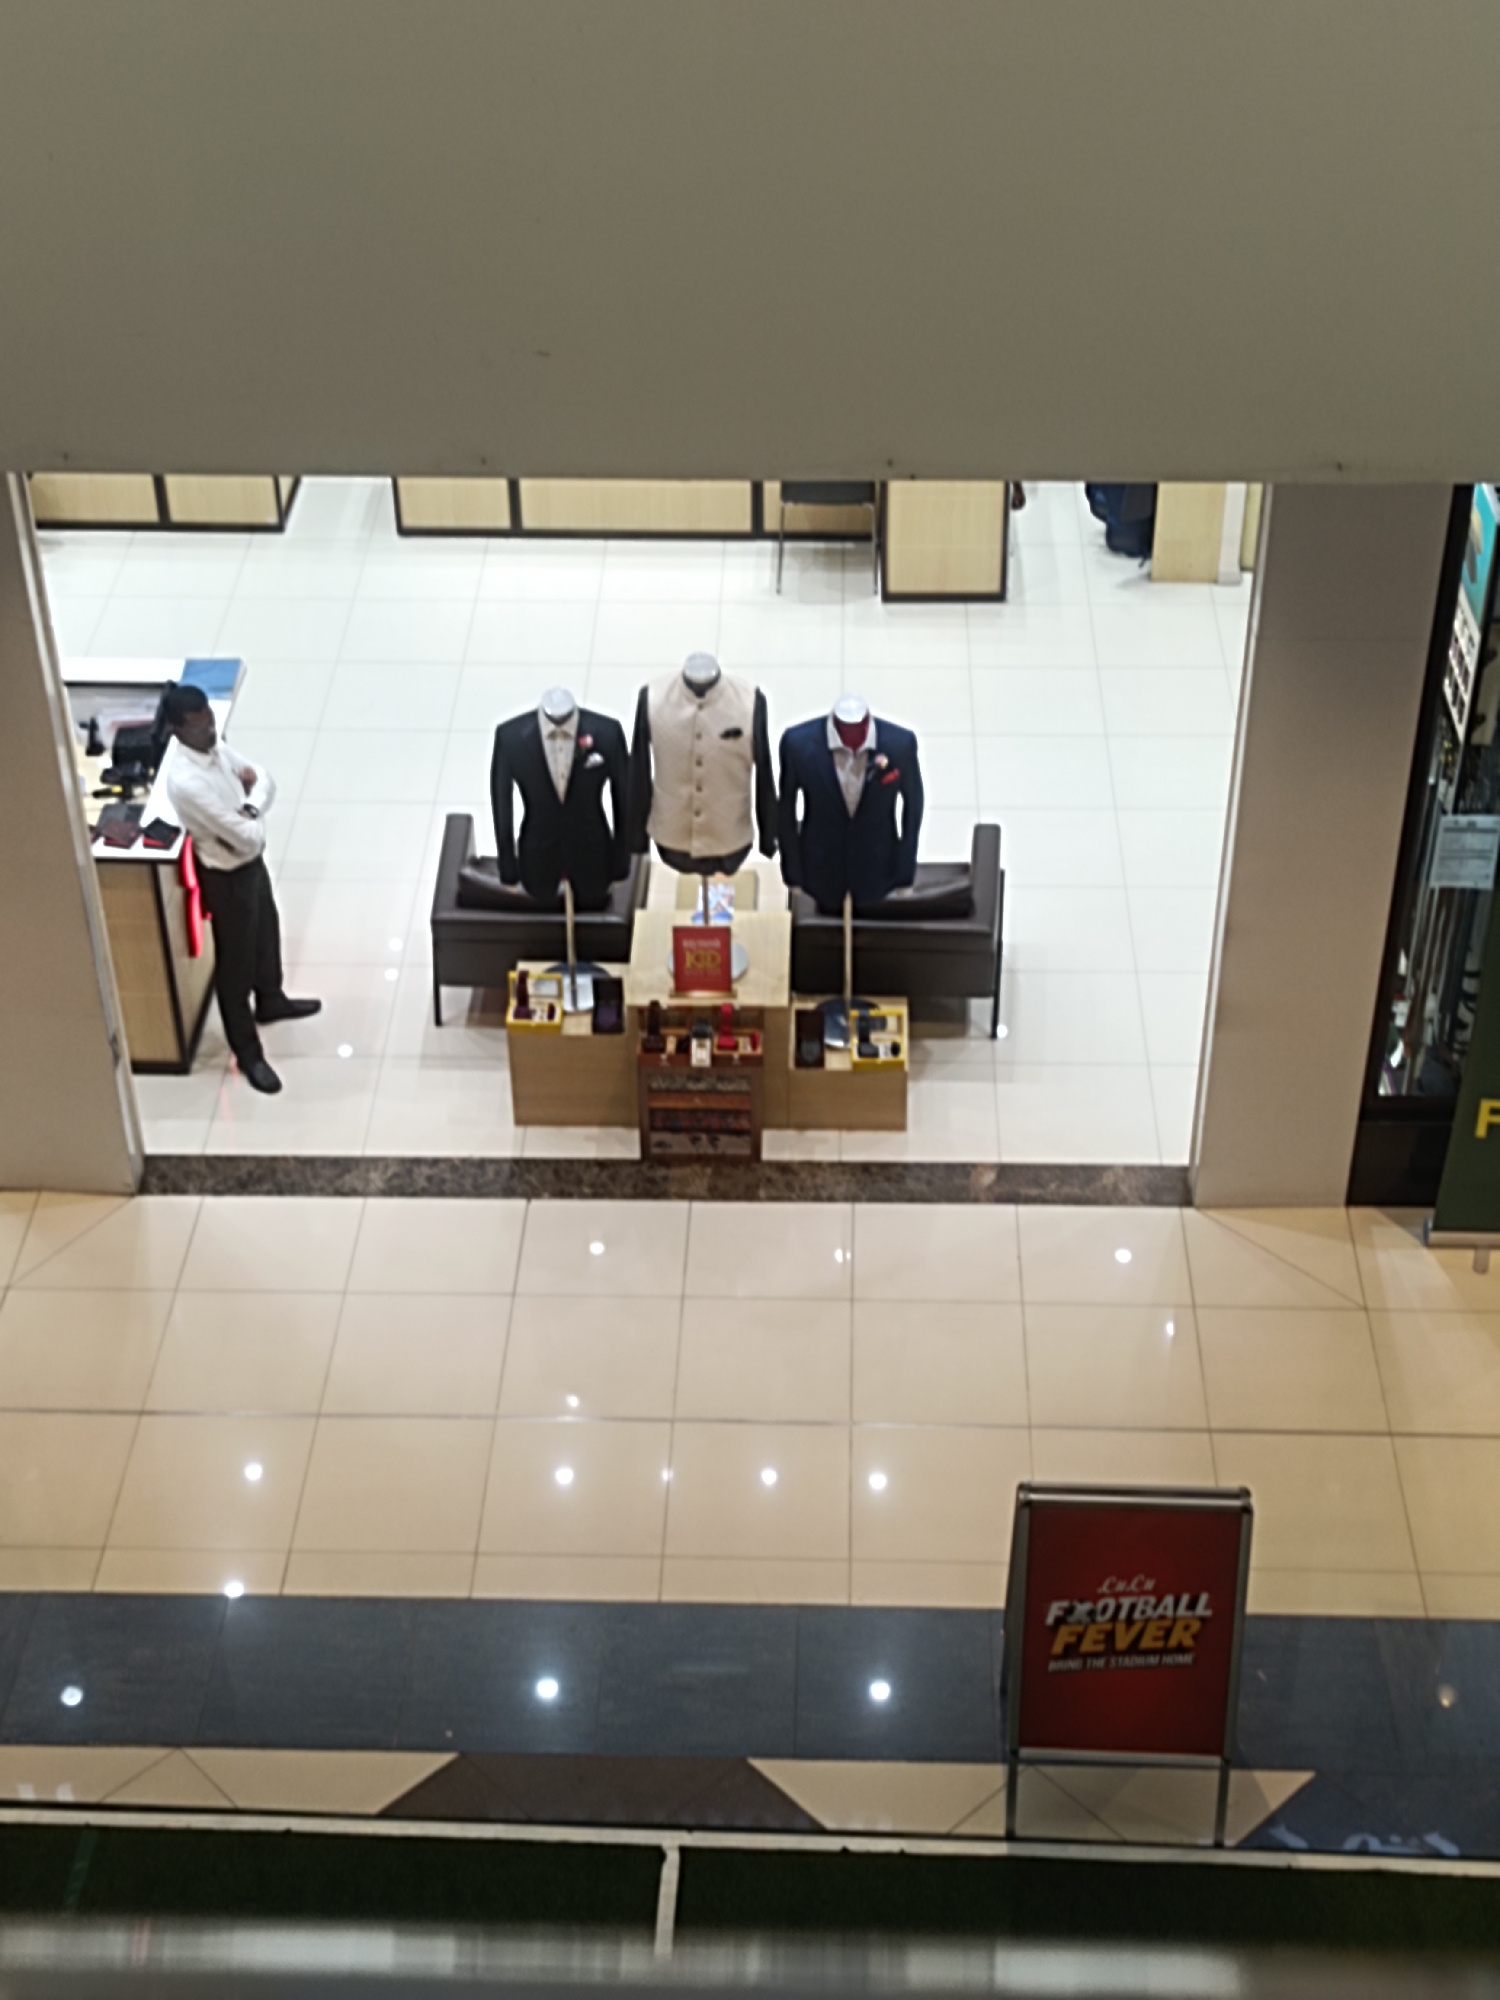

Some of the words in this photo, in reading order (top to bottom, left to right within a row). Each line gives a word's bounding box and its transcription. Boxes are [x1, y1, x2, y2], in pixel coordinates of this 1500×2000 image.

[1049, 1617, 1202, 1655] FEVER
[1047, 1658, 1083, 1672] BRING
[1087, 1656, 1106, 1670] THE
[1109, 1654, 1160, 1669] STADIUM
[1162, 1653, 1194, 1666] HOME
